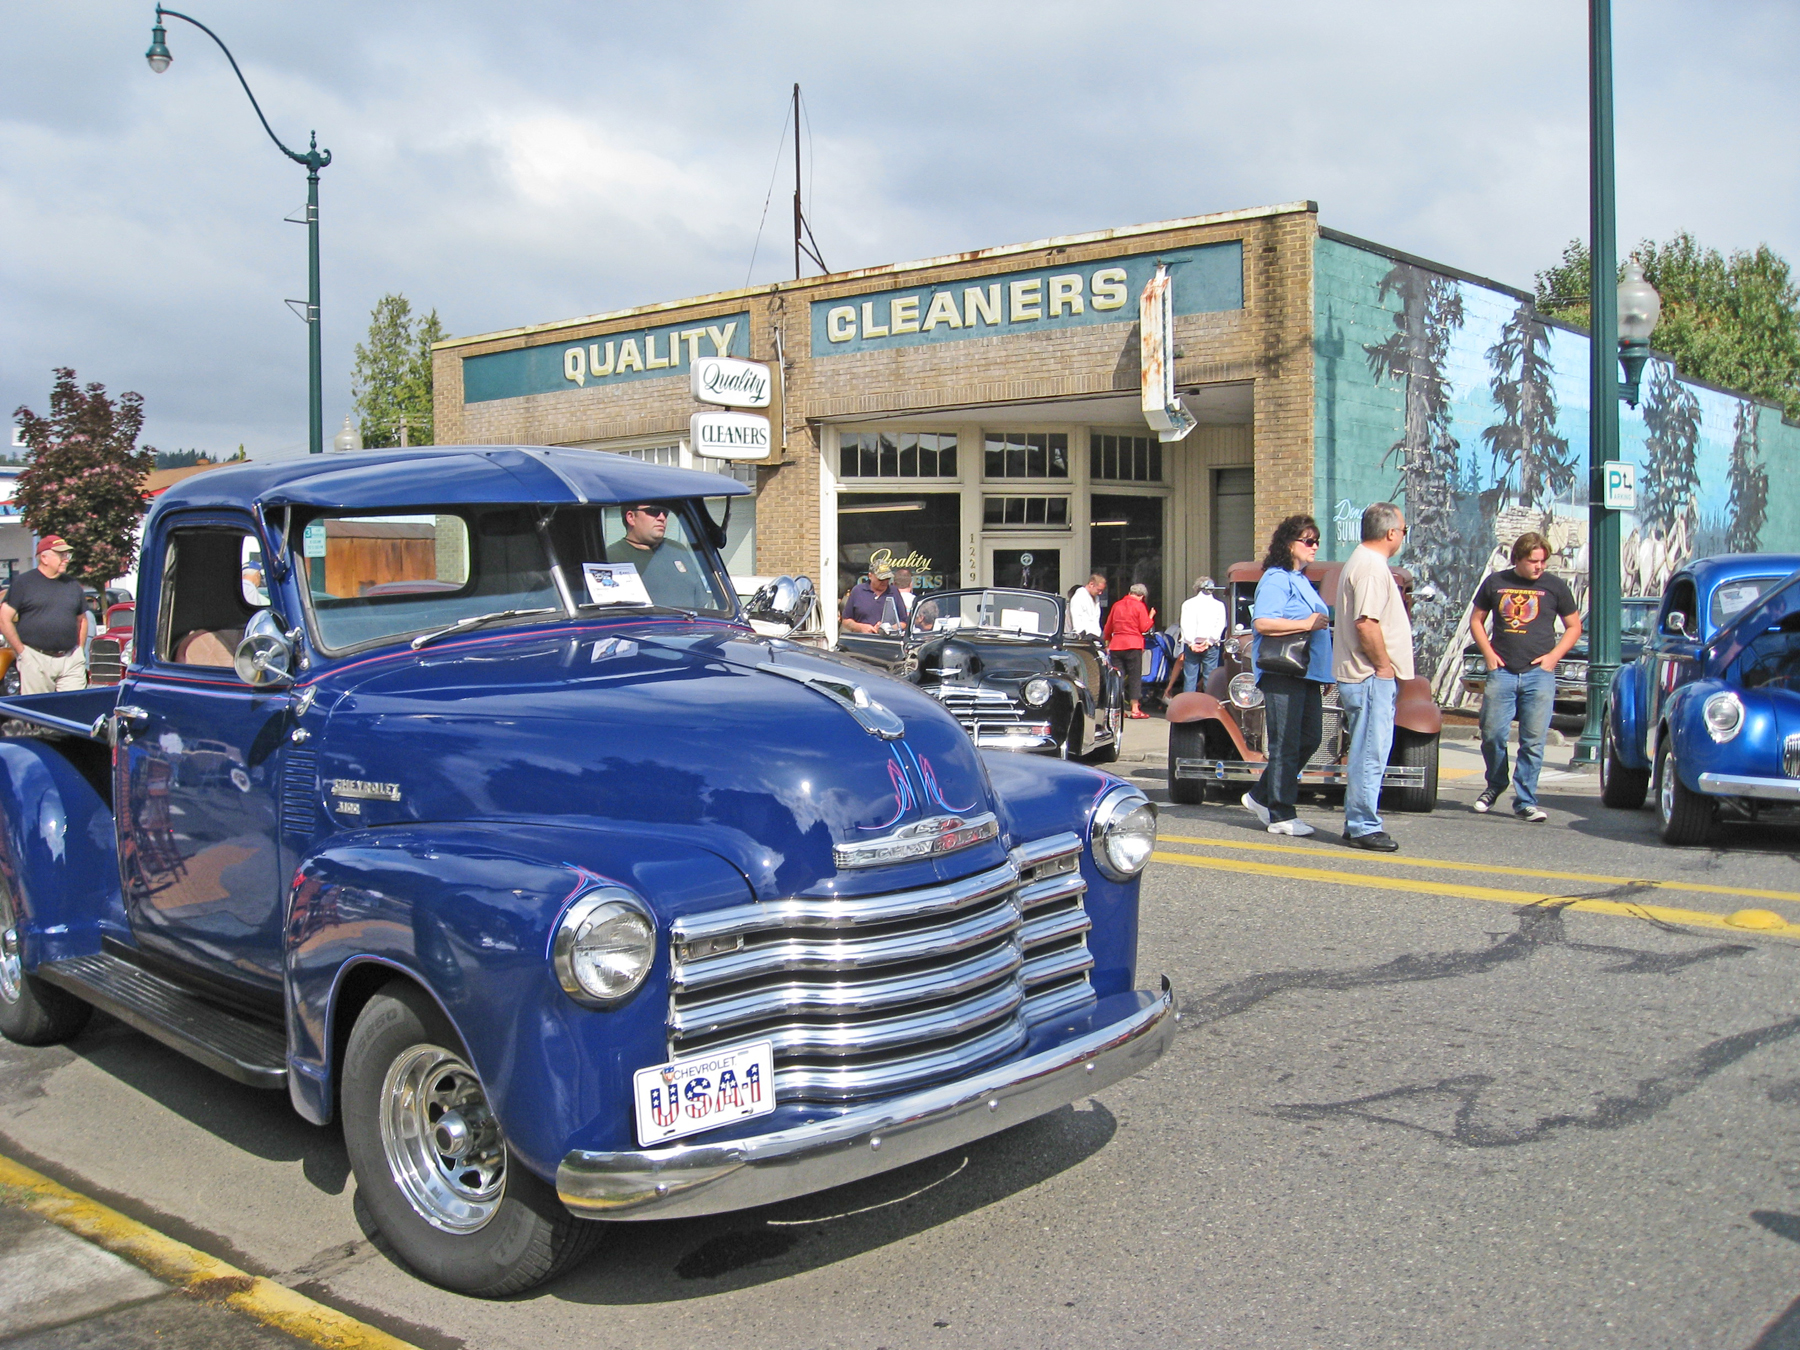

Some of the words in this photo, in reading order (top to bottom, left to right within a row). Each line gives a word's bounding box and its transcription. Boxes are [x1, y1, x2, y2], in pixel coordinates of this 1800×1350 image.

[564, 322, 737, 387] QUALITY
[827, 268, 1128, 343] CLEANERS
[703, 363, 766, 403] Quality
[702, 425, 767, 445] CLEANERS
[870, 548, 932, 573] Quality
[968, 533, 977, 582] 1229
[334, 779, 400, 796] CHEVROLET
[875, 827, 993, 861] CHEVROLET
[673, 1056, 737, 1081] CHEVROLET
[650, 1063, 761, 1127] USA-1
